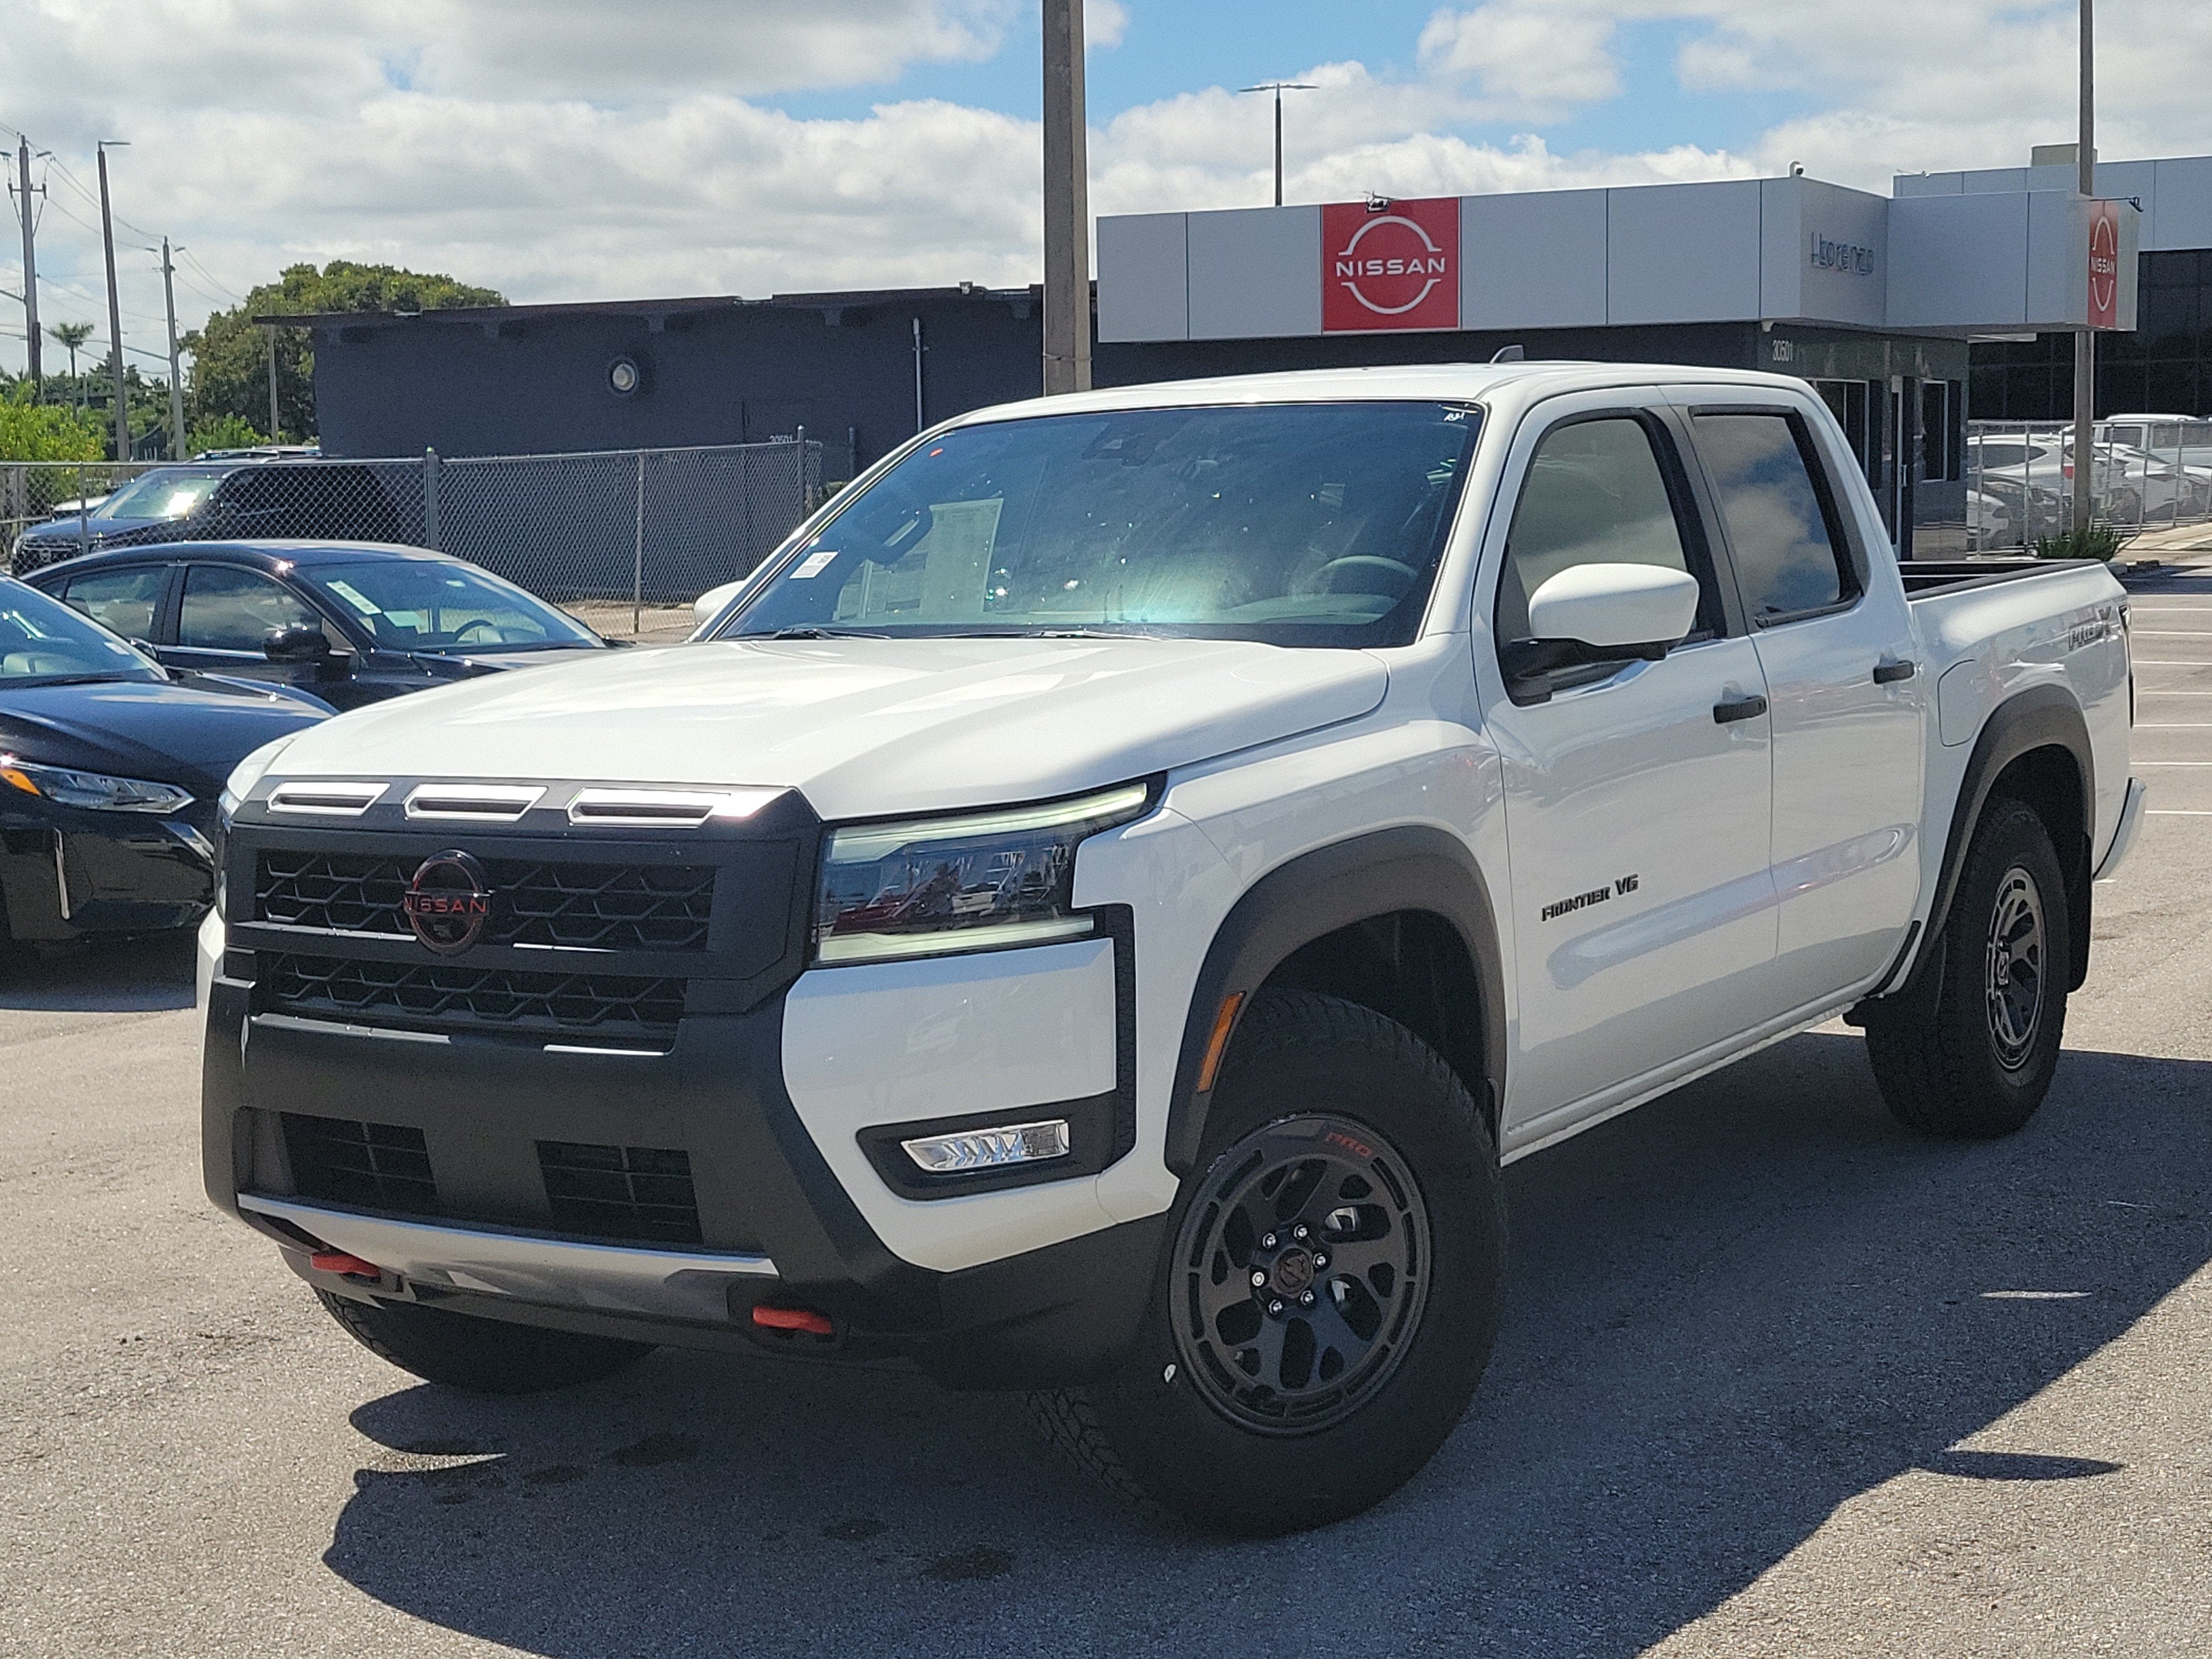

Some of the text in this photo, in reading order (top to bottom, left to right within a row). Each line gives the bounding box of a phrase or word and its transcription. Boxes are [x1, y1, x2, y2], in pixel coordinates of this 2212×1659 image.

[1336, 258, 1446, 277] NISSAN
[2091, 256, 2115, 274] NISSAN
[404, 895, 487, 914] NISSAN
[1542, 873, 1639, 922] FRONTIER V6
[1324, 1131, 1373, 1157] PRO
